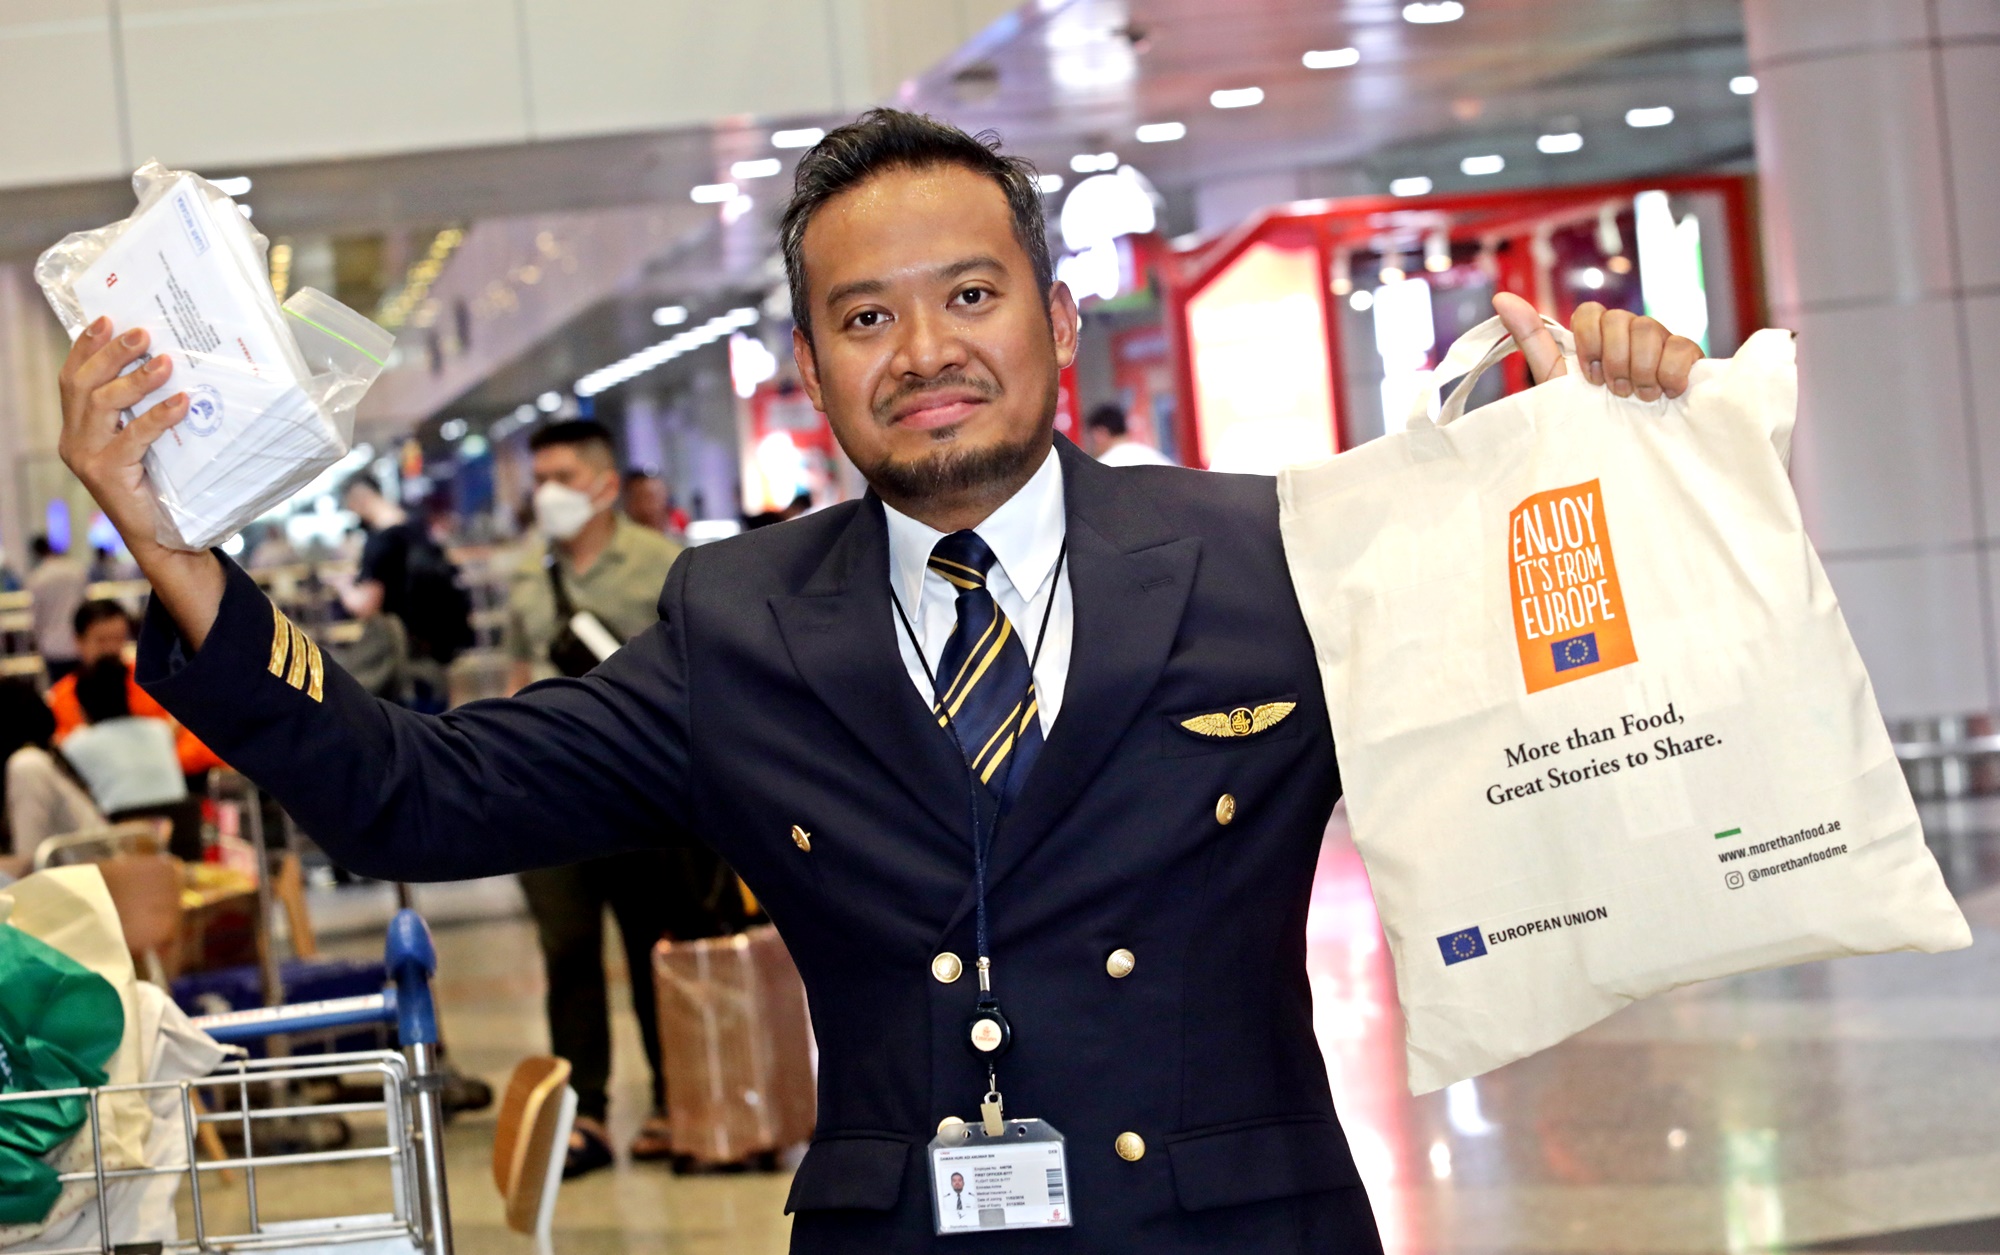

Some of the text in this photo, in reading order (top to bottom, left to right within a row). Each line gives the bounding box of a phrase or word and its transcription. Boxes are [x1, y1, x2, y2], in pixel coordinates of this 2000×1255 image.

[176, 196, 204, 251] LUAR NEGARA
[1513, 492, 1596, 563] ENJOY
[1516, 544, 1605, 596] IT'S FROM
[1520, 579, 1615, 640] EUROPE
[1504, 702, 1685, 768] More than Food,
[1486, 732, 1723, 805] Great Stories to Share.
[1718, 820, 1841, 863] www.morethanfood.ae
[1748, 844, 1848, 881] @morethanfoodme
[1488, 906, 1608, 945] EUROPEAN UNION
